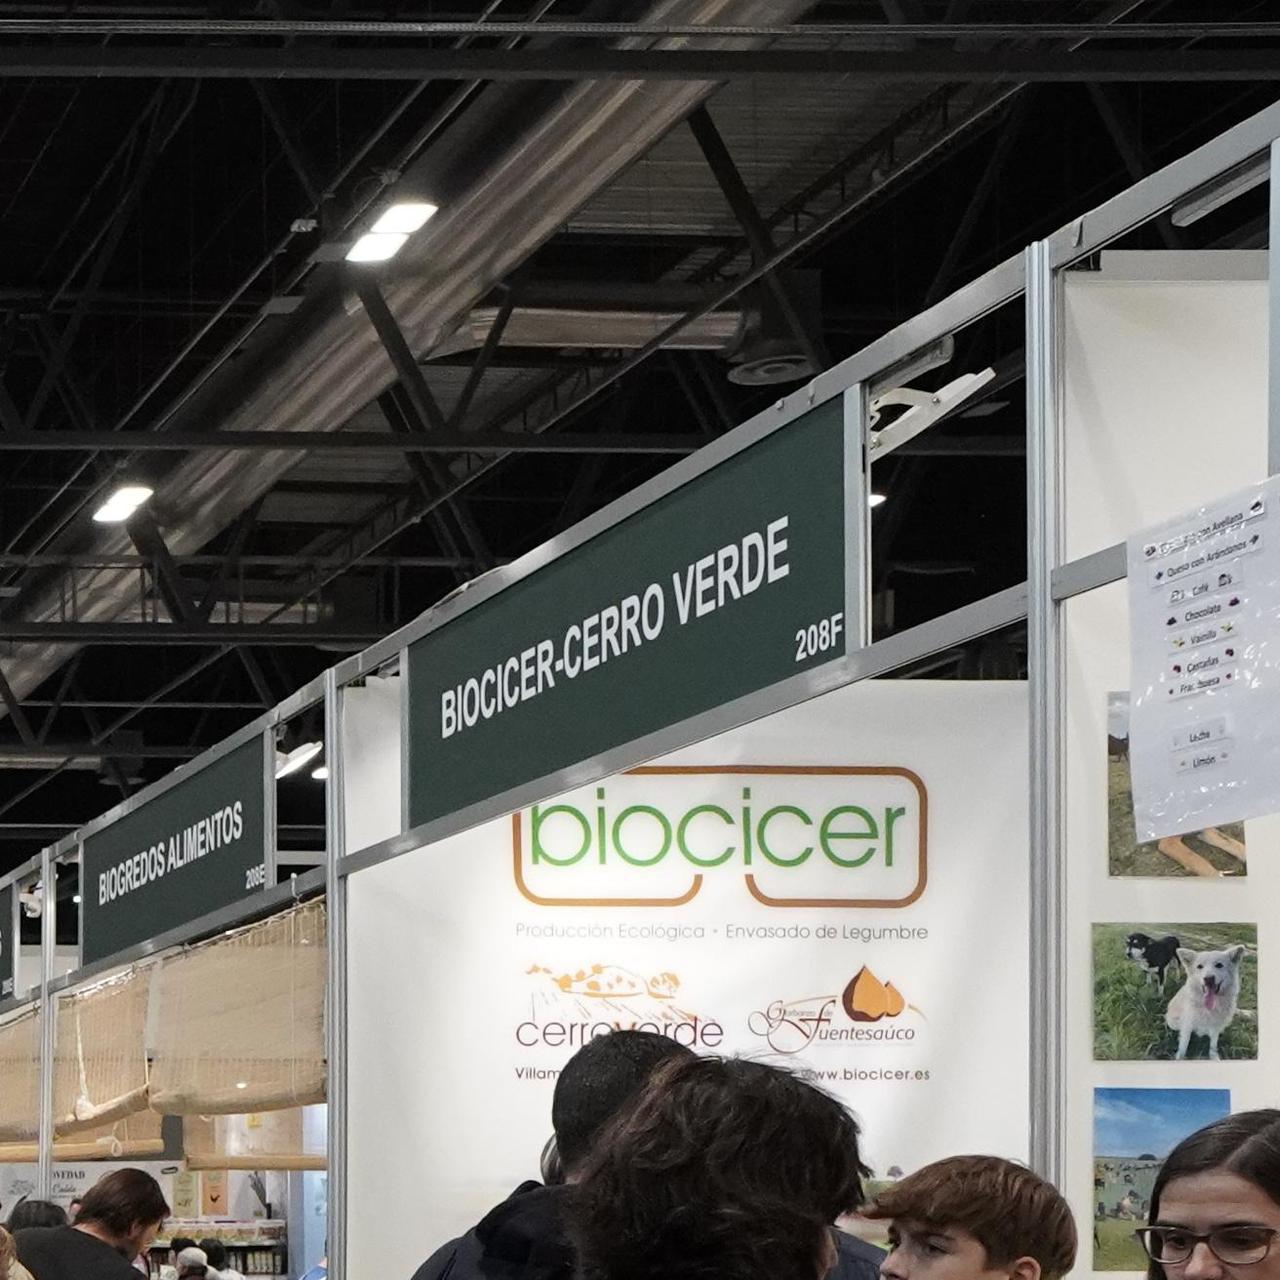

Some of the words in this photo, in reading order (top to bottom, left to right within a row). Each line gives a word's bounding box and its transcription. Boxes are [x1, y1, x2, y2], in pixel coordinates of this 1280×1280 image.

[1167, 563, 1190, 577] Queso
[1191, 557, 1205, 568] con
[441, 583, 665, 739] BIOCICER-CERRO
[672, 515, 790, 625] VERDE
[794, 613, 843, 662] 208F
[1185, 605, 1221, 621] Chocolate
[531, 787, 906, 867] biocicer
[99, 842, 165, 905] BIOGREDOS
[167, 801, 242, 873] ALIMENTOS
[516, 922, 613, 939] Producción
[619, 922, 705, 941] Ecológica
[726, 923, 810, 940] Envasado
[815, 923, 838, 940] de
[843, 923, 928, 943] Legumbre
